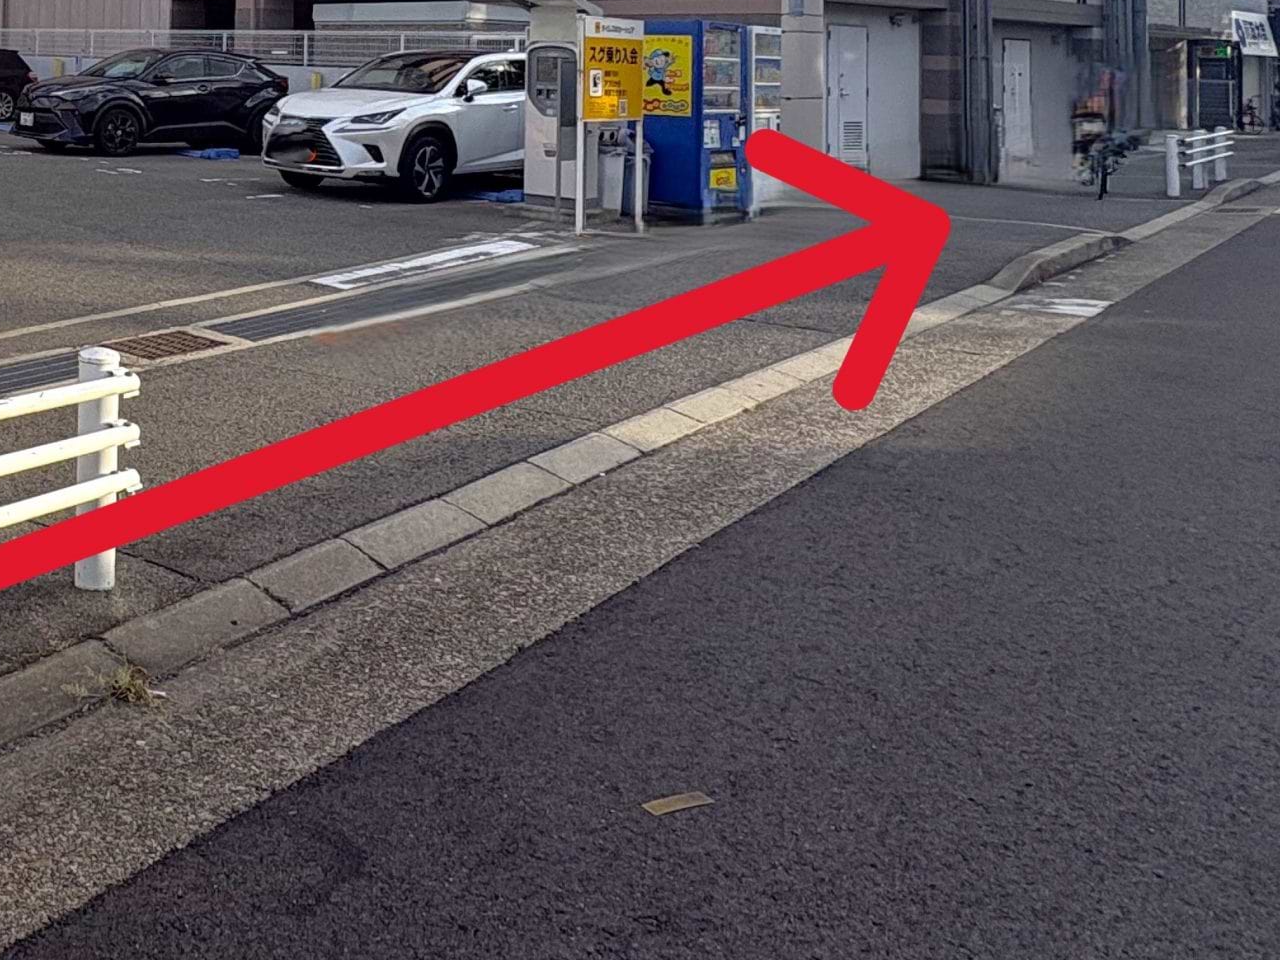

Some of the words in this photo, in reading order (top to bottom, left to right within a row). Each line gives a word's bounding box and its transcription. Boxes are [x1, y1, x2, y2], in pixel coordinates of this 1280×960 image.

[588, 46, 639, 65] スグ乗り入会
